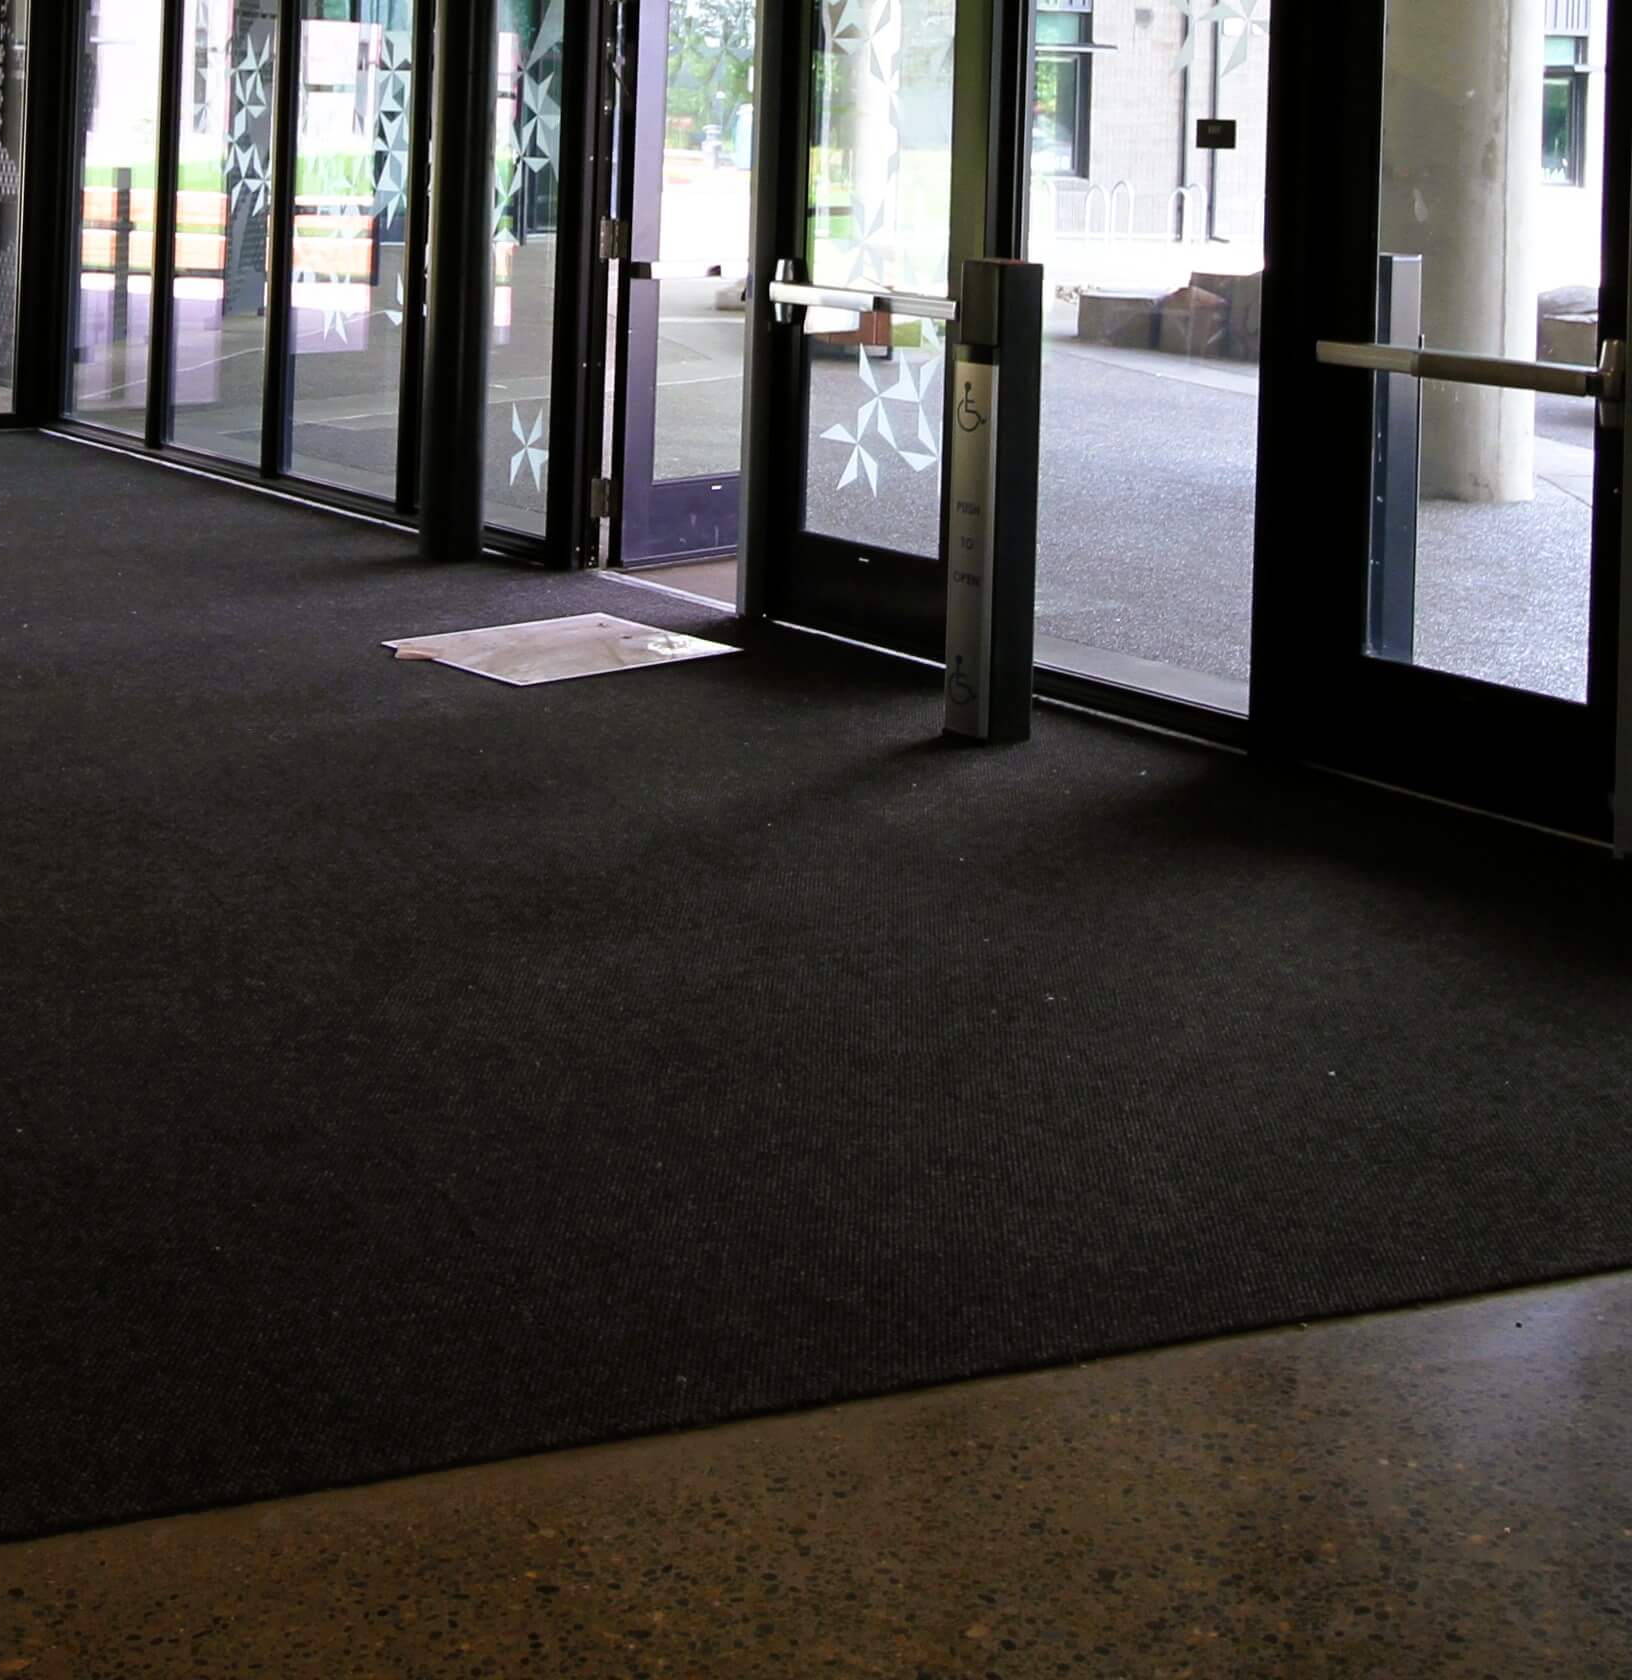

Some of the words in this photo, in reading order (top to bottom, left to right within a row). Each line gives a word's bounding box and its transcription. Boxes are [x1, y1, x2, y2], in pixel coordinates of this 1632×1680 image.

[956, 501, 981, 515] PUSH
[961, 536, 974, 550] TO
[953, 570, 981, 587] OPEN
